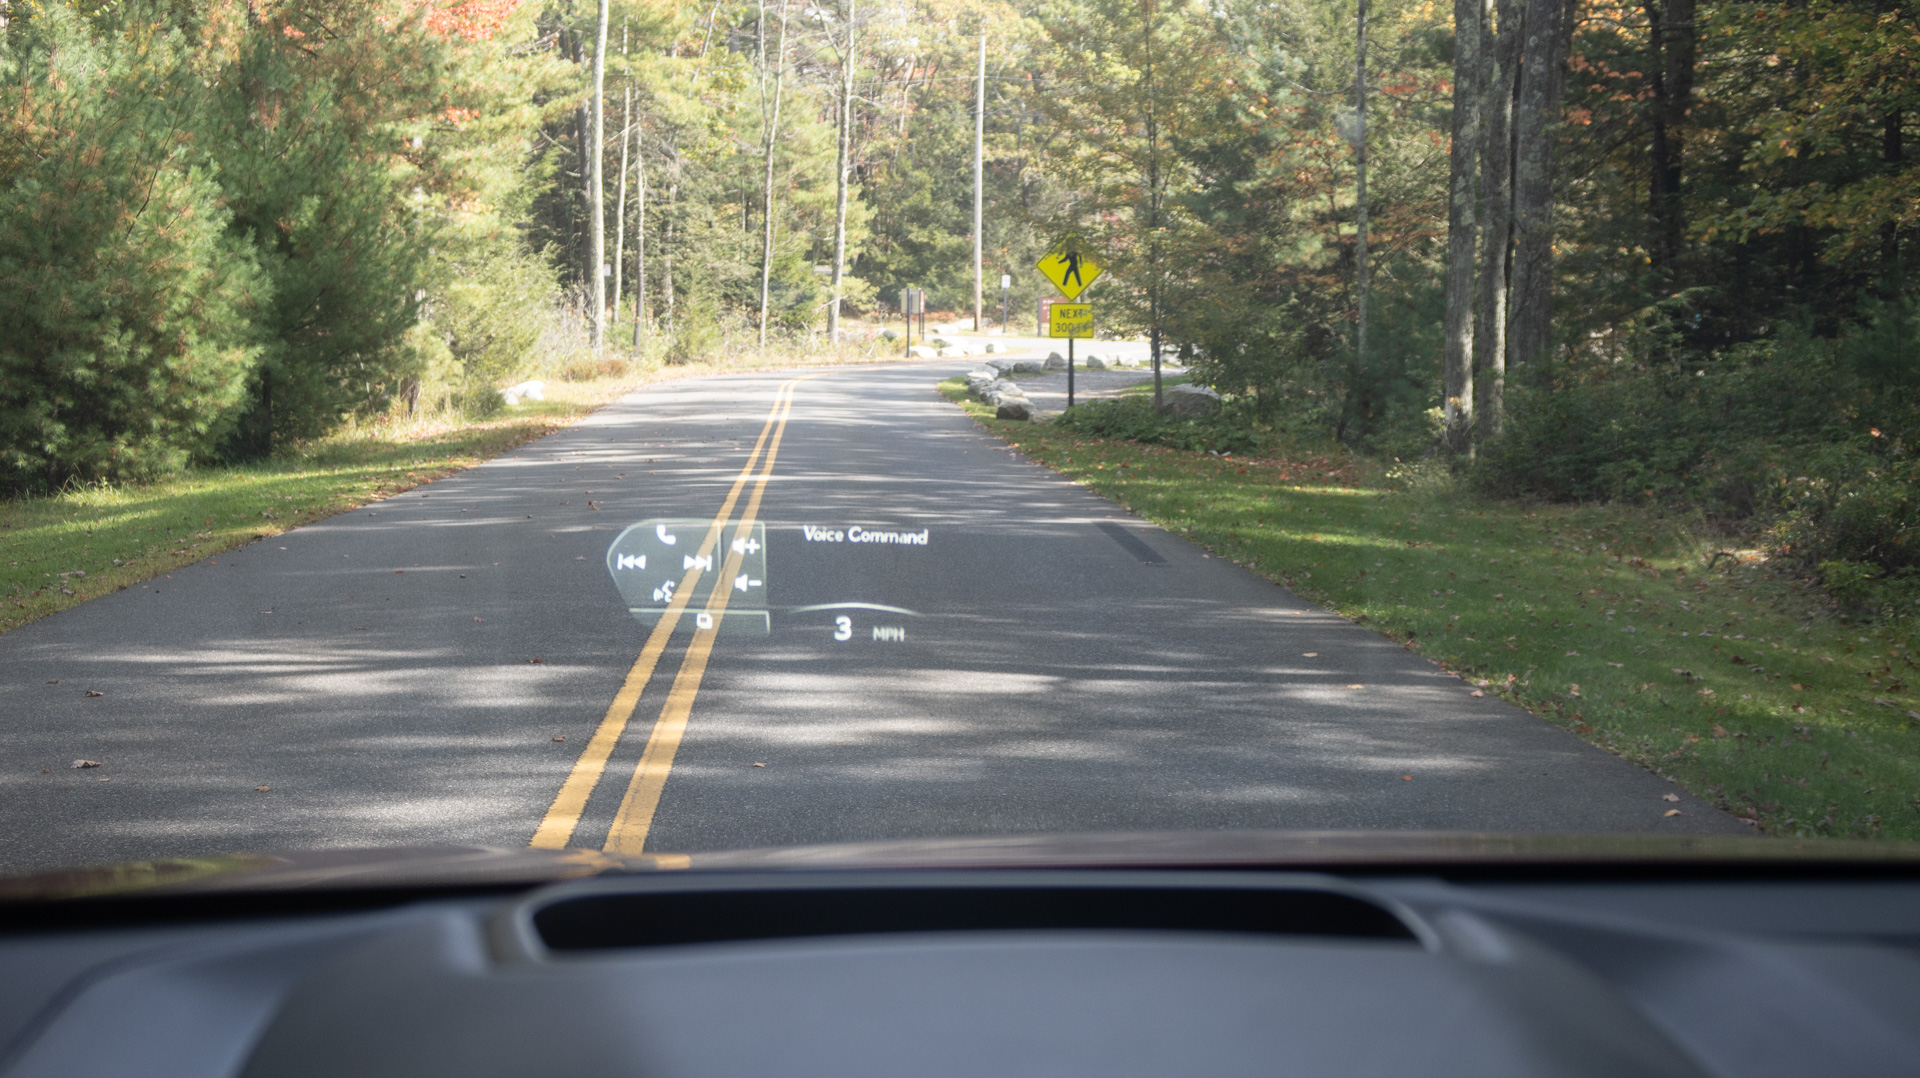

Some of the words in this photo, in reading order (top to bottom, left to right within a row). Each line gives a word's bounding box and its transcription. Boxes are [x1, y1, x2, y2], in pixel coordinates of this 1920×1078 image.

[1060, 309, 1083, 319] NEXT
[1055, 322, 1074, 333] 300
[803, 525, 844, 542] Voice
[848, 526, 929, 545] Command
[834, 615, 852, 641] 3
[873, 626, 905, 642] MPH
